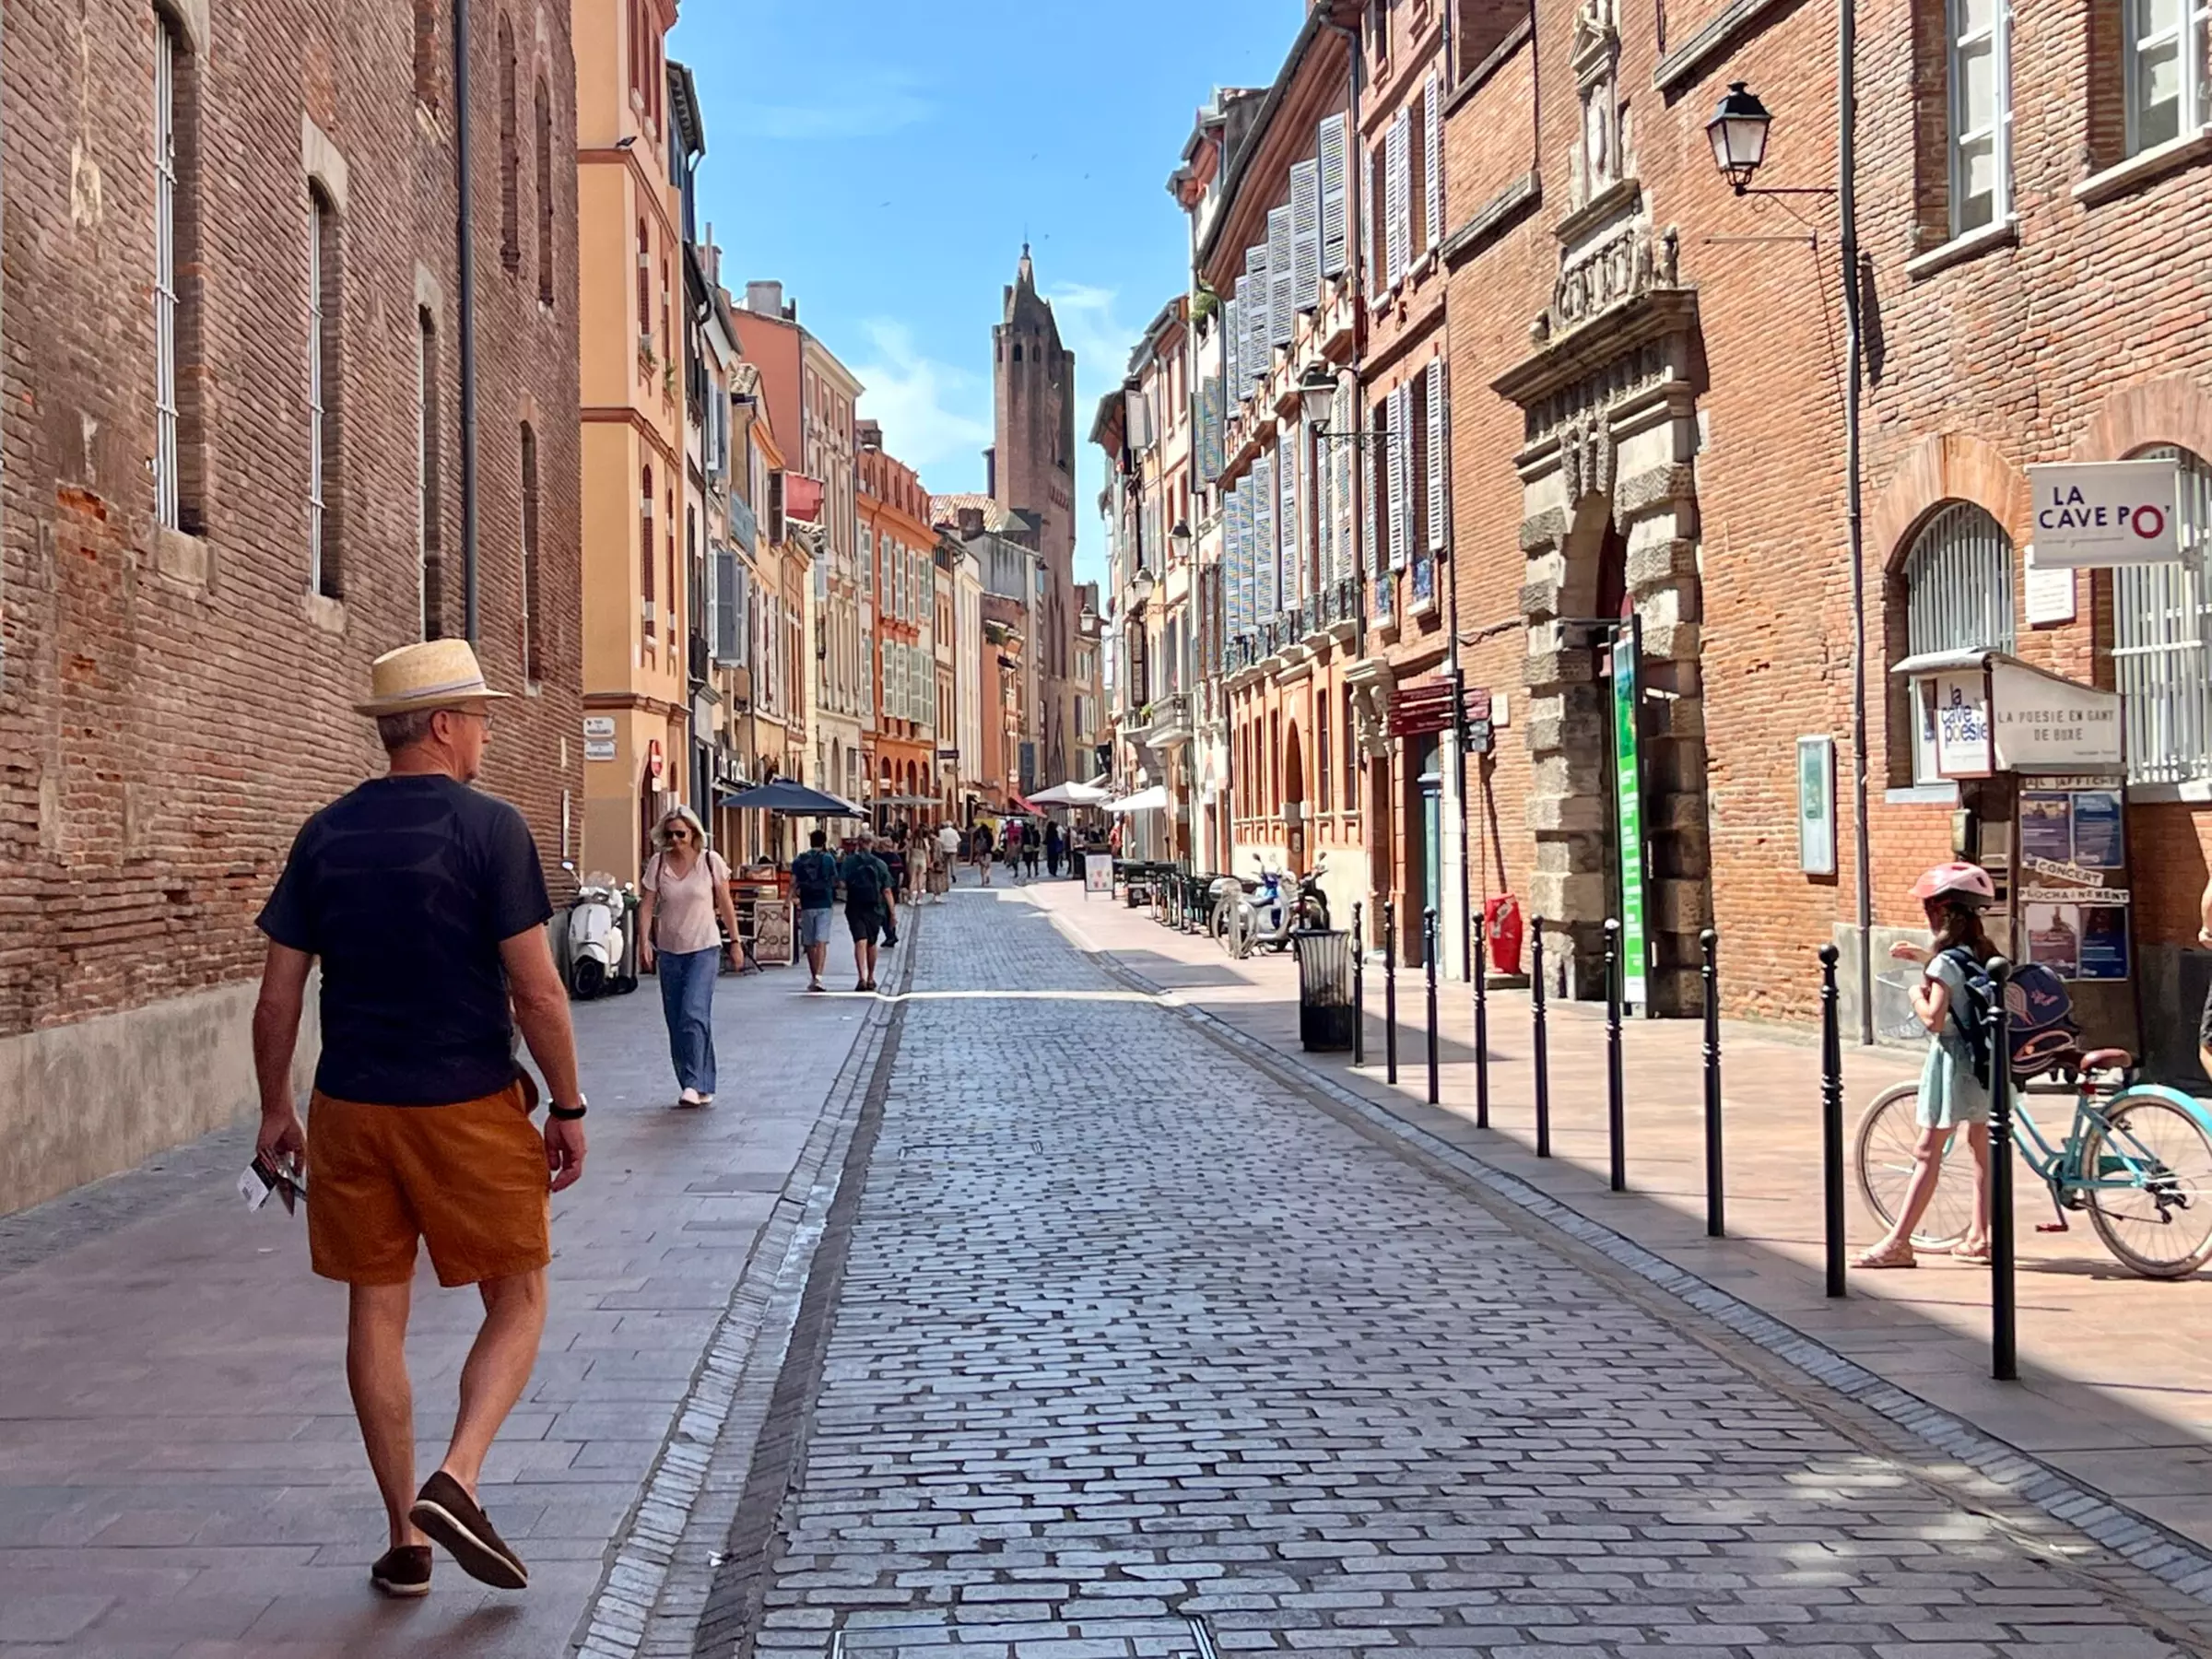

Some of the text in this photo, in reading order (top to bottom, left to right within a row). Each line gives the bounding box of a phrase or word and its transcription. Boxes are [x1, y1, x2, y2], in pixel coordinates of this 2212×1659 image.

[2053, 486, 2085, 506] LA
[2039, 507, 2108, 529] CAVE
[1949, 682, 1962, 705] la
[1942, 705, 1972, 724] cave
[1997, 712, 2013, 724] LA
[2069, 709, 2083, 723] EN
[2034, 728, 2050, 742] DE
[2038, 861, 2100, 884] CONCERT
